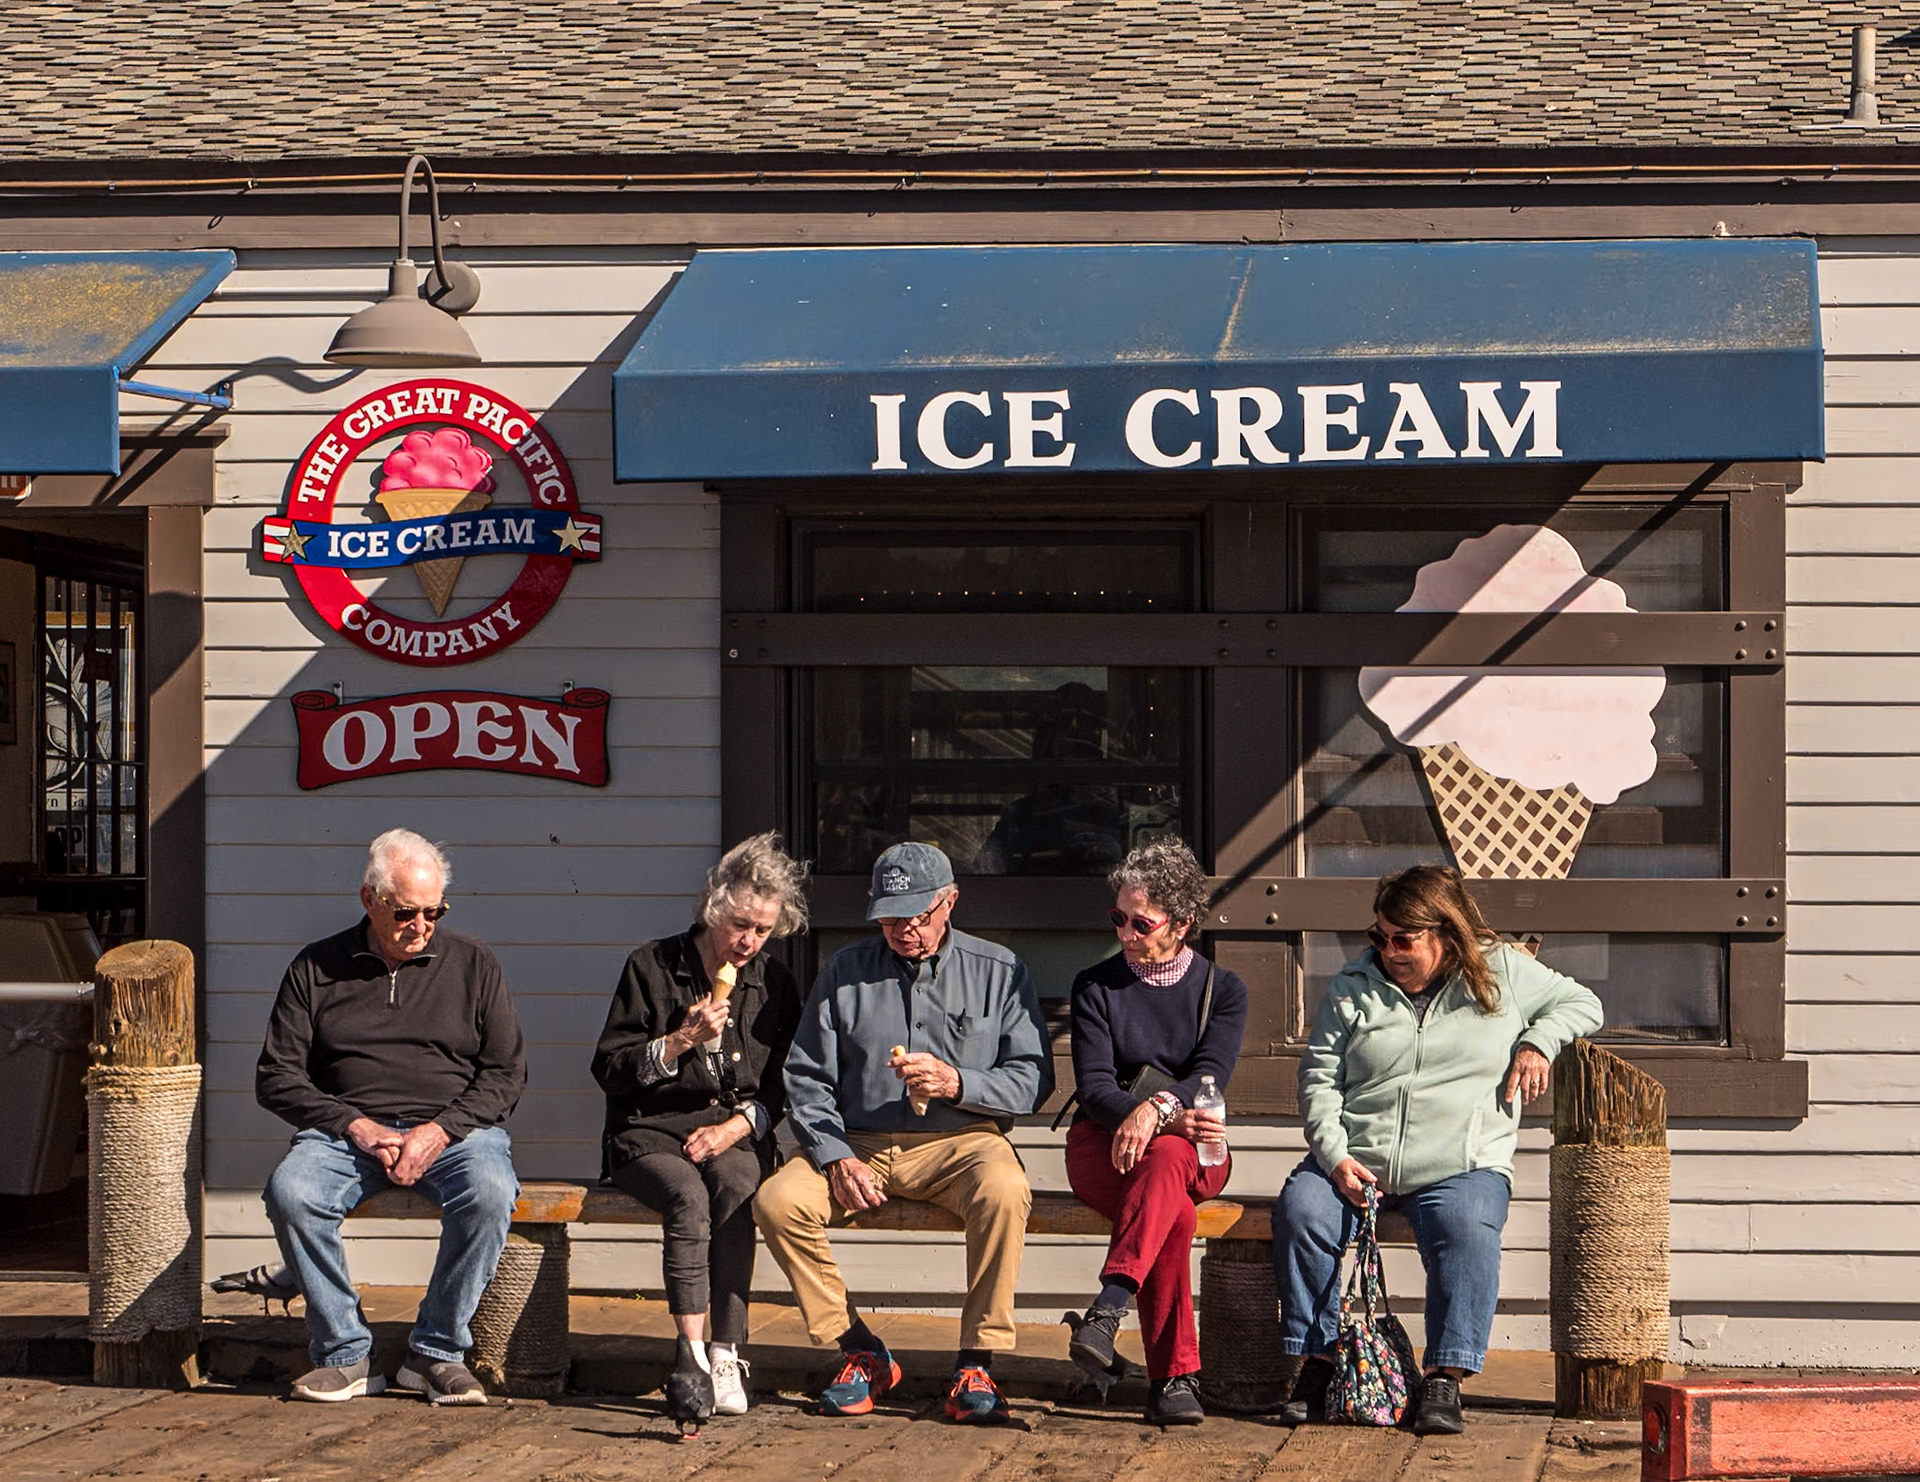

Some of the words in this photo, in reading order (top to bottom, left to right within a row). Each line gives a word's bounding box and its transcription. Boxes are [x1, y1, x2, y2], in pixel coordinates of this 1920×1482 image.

[298, 435, 349, 503] THE
[343, 387, 460, 441] GREAT
[463, 393, 567, 505] PACIFIC
[870, 389, 1077, 471] ICE
[1125, 380, 1564, 469] CREAM
[328, 529, 389, 558] ICE
[397, 518, 535, 556] CREAM
[341, 601, 521, 658] COMPANY
[322, 700, 582, 775] OPEN
